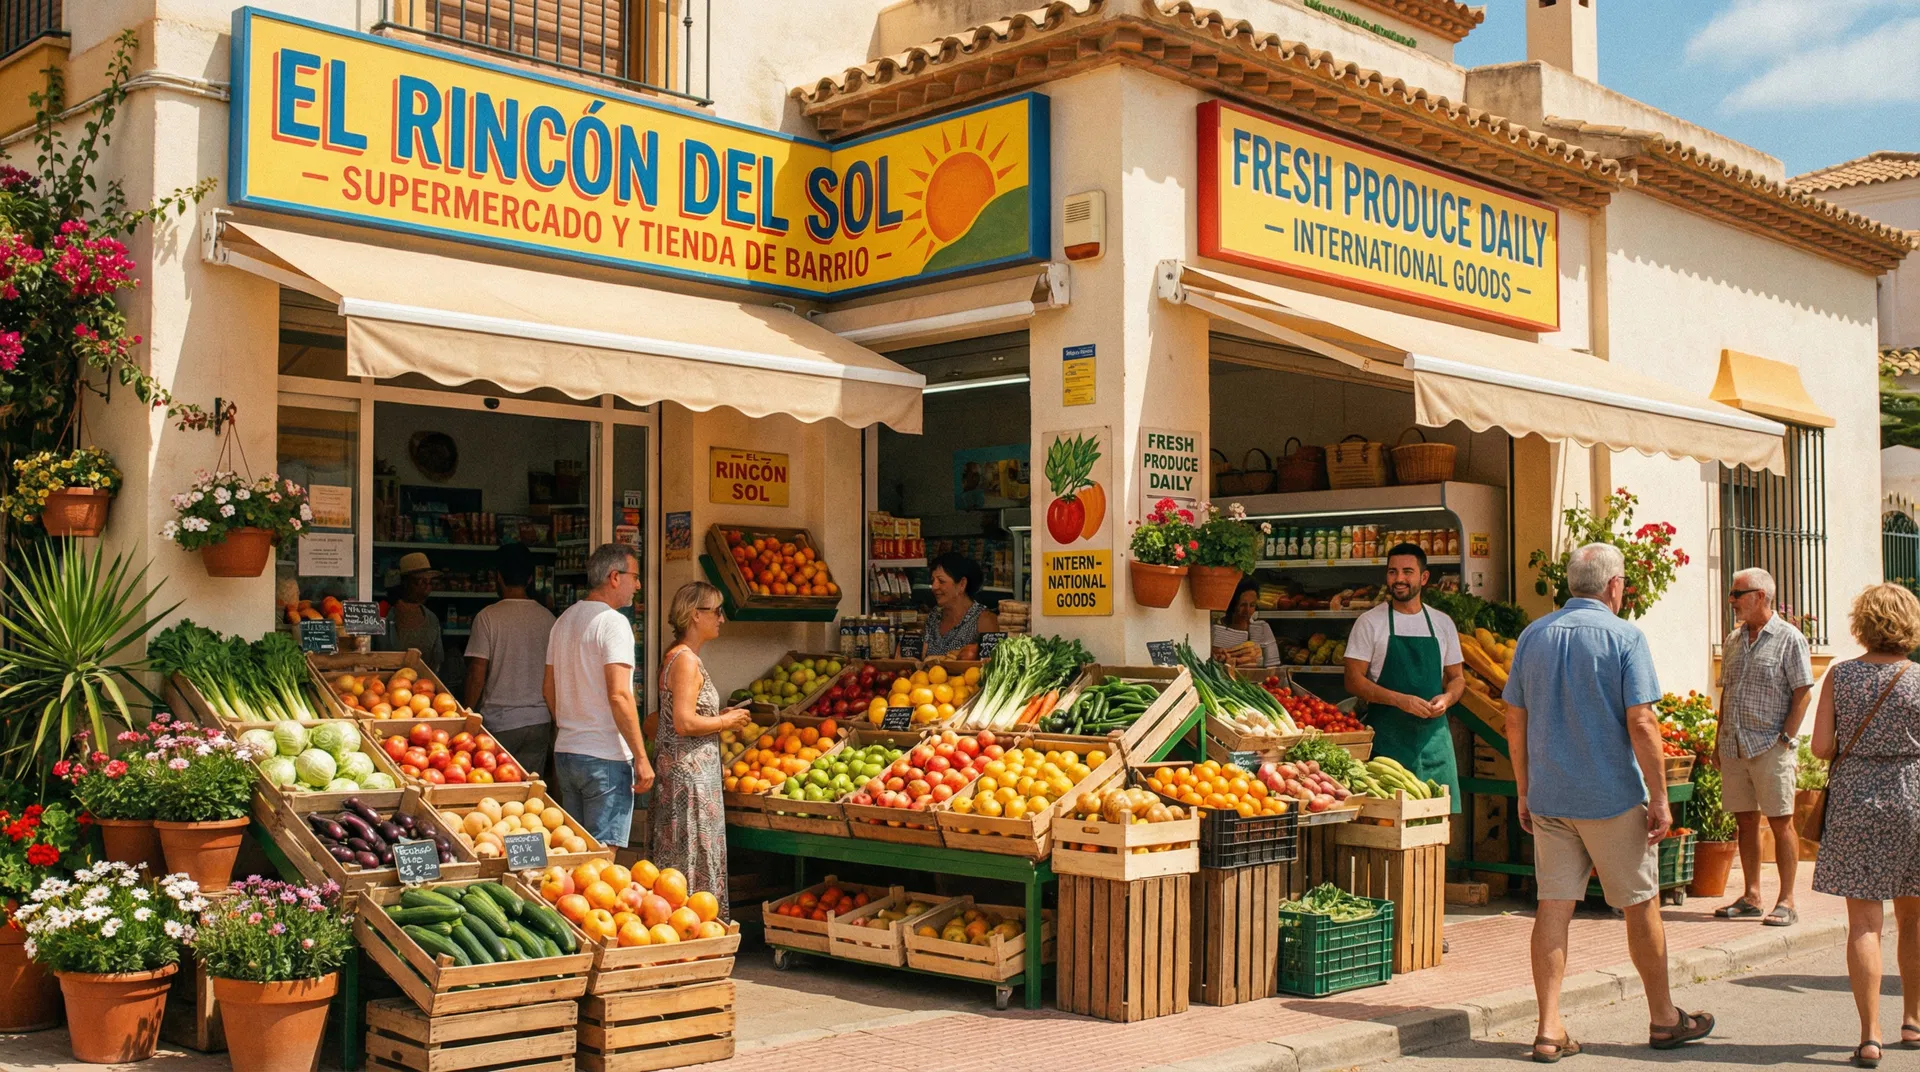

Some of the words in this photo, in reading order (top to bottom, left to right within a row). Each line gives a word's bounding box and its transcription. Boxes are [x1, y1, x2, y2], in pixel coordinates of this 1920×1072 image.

[271, 47, 367, 155] EL
[391, 74, 658, 211] RINCÓN
[679, 139, 789, 237] DEL
[804, 155, 904, 245] SOL
[1232, 128, 1333, 211] FRESH
[1343, 162, 1471, 249] PRODUCE
[1480, 203, 1547, 269] DAILY
[342, 165, 602, 243] SUPERMERCADO
[612, 216, 630, 248] Y
[640, 221, 736, 267] TIENDA
[745, 239, 776, 274] DE
[785, 246, 869, 283] BARRIO
[1293, 217, 1447, 287] INTERNATIONAL
[1453, 260, 1511, 303] GOODS
[1148, 433, 1194, 453] FRESH
[746, 453, 759, 461] EL
[1144, 453, 1198, 473] PRODUCE
[716, 460, 786, 483] RINCÓN
[732, 483, 770, 502] SOL
[1150, 473, 1193, 492] DAILY
[1052, 555, 1102, 571] INTERN-
[1048, 573, 1106, 590] NATIONAL
[1056, 591, 1096, 608] GOODS
